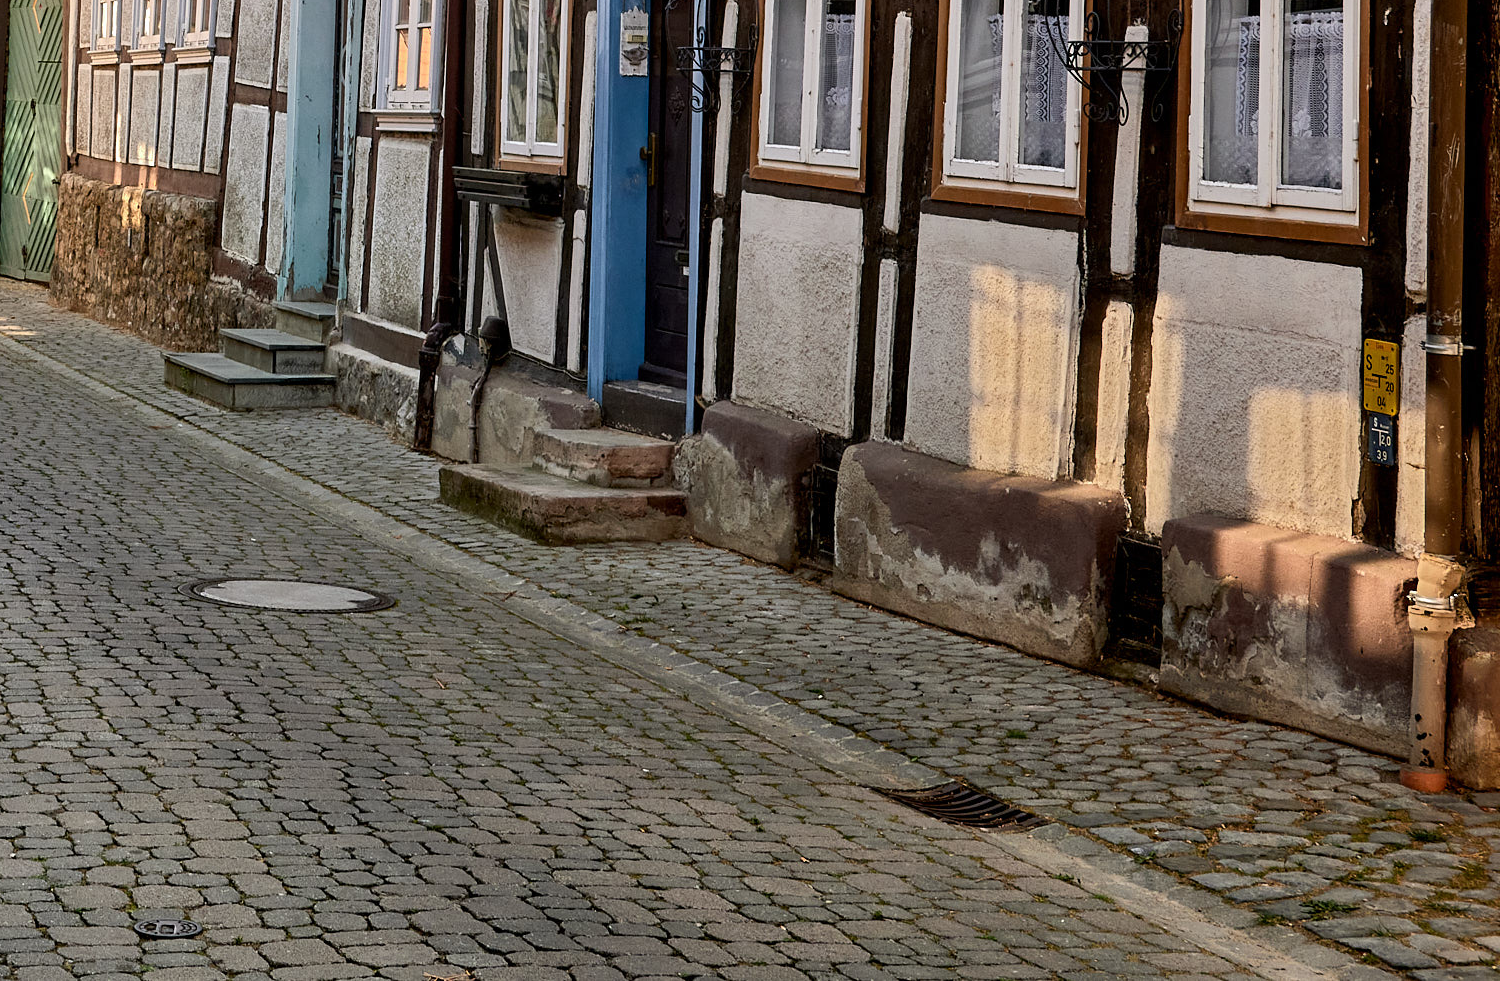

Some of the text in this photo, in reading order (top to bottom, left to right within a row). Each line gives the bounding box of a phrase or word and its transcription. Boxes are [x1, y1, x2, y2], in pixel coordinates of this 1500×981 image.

[1366, 354, 1373, 371] S
[1385, 363, 1395, 375] 25
[1373, 416, 1378, 428] S
